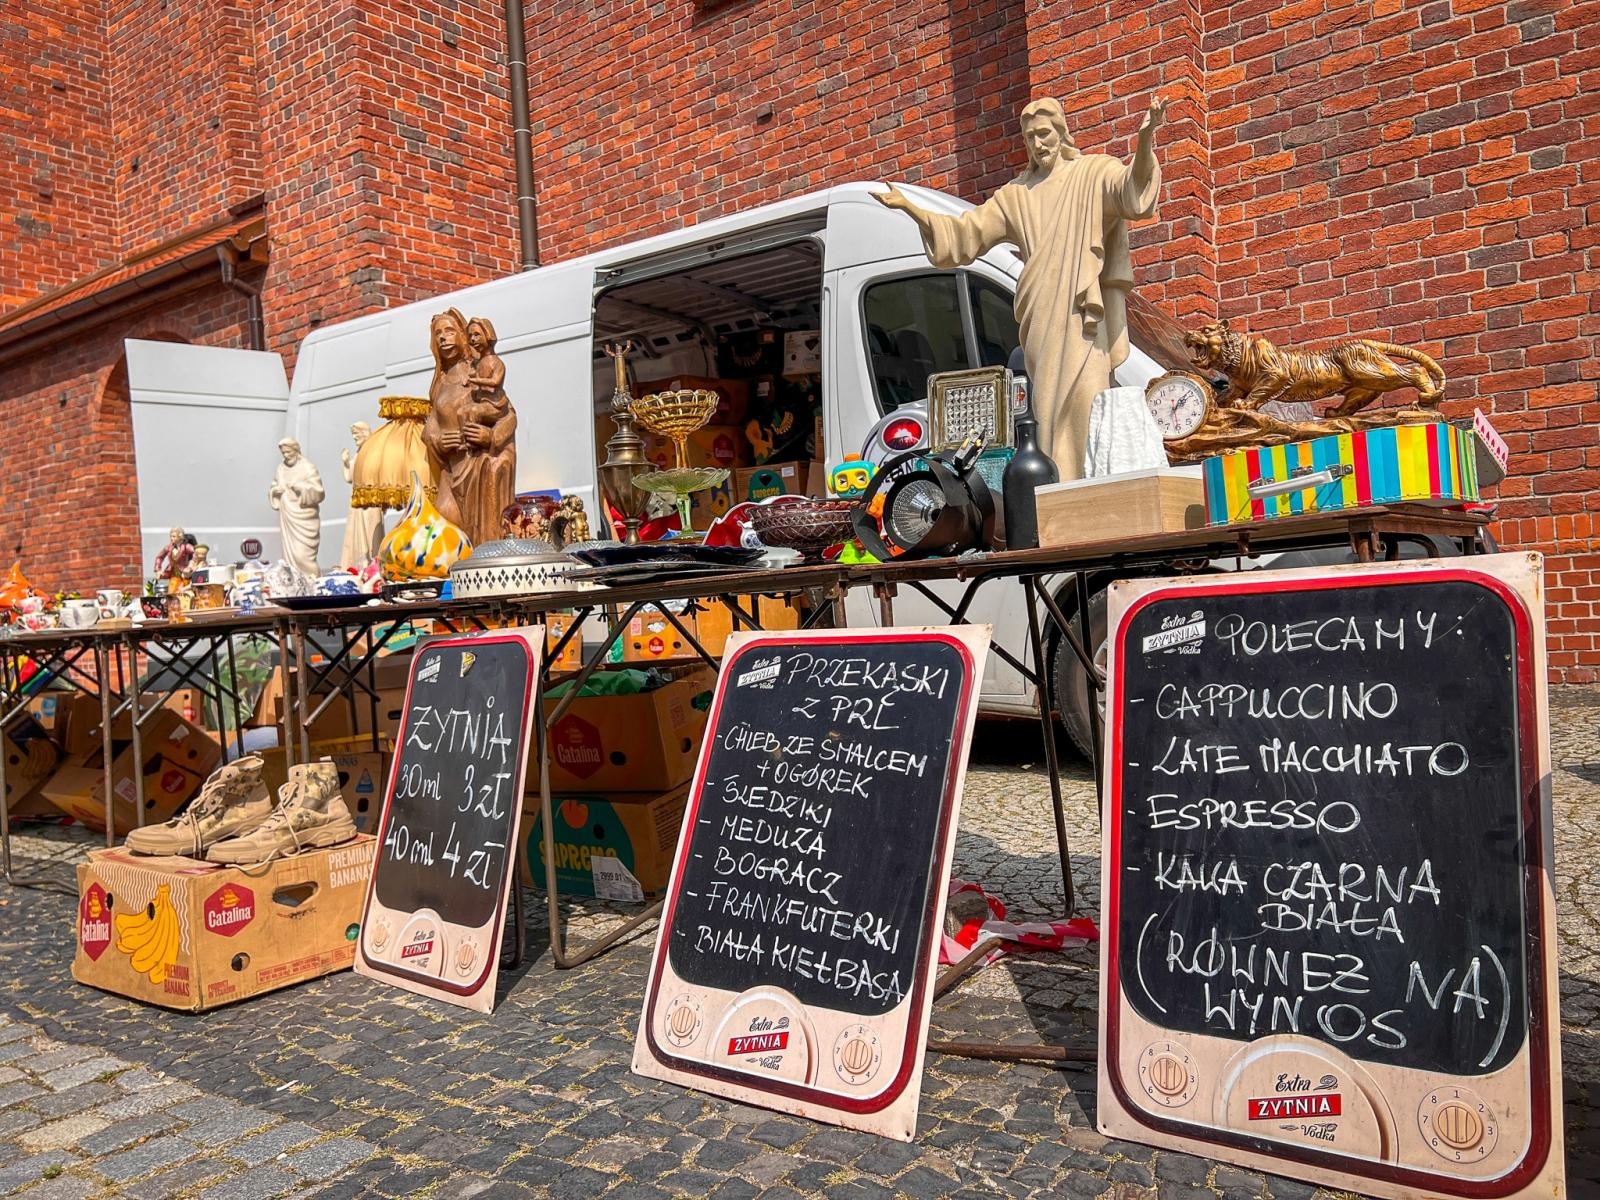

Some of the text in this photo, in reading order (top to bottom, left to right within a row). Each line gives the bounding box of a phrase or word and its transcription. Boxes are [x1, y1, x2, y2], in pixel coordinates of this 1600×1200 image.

[1161, 614, 1187, 630] Extra
[791, 697, 821, 719] Z
[1156, 682, 1398, 721] CAPPUCCINO
[556, 742, 601, 764] Catalina
[783, 735, 815, 755] ZE
[818, 738, 928, 778] SMALCEM
[1151, 735, 1470, 778] LATE MACCHIATO
[1146, 793, 1361, 836] ESPRESSO
[720, 814, 827, 861] MEDUZA
[713, 846, 843, 905] BOGRACZ
[1264, 858, 1441, 906] CZARNA
[82, 917, 110, 943] Catalina
[208, 906, 252, 928] Catalina
[705, 881, 900, 954] FRANKFUTERKI
[1257, 902, 1405, 944] BIAŁA
[694, 925, 905, 1007] BIAŁA KIEŁBASA
[749, 1016, 773, 1032] Extra
[1203, 981, 1408, 1050] WYNOS
[1141, 1044, 1195, 1105] 1 2 3 4 5 6 7 8
[1275, 1072, 1312, 1093] Extra
[1301, 1123, 1336, 1142] Vodka
[1422, 1089, 1493, 1160] 1 2 3 4 5 6 7 8
